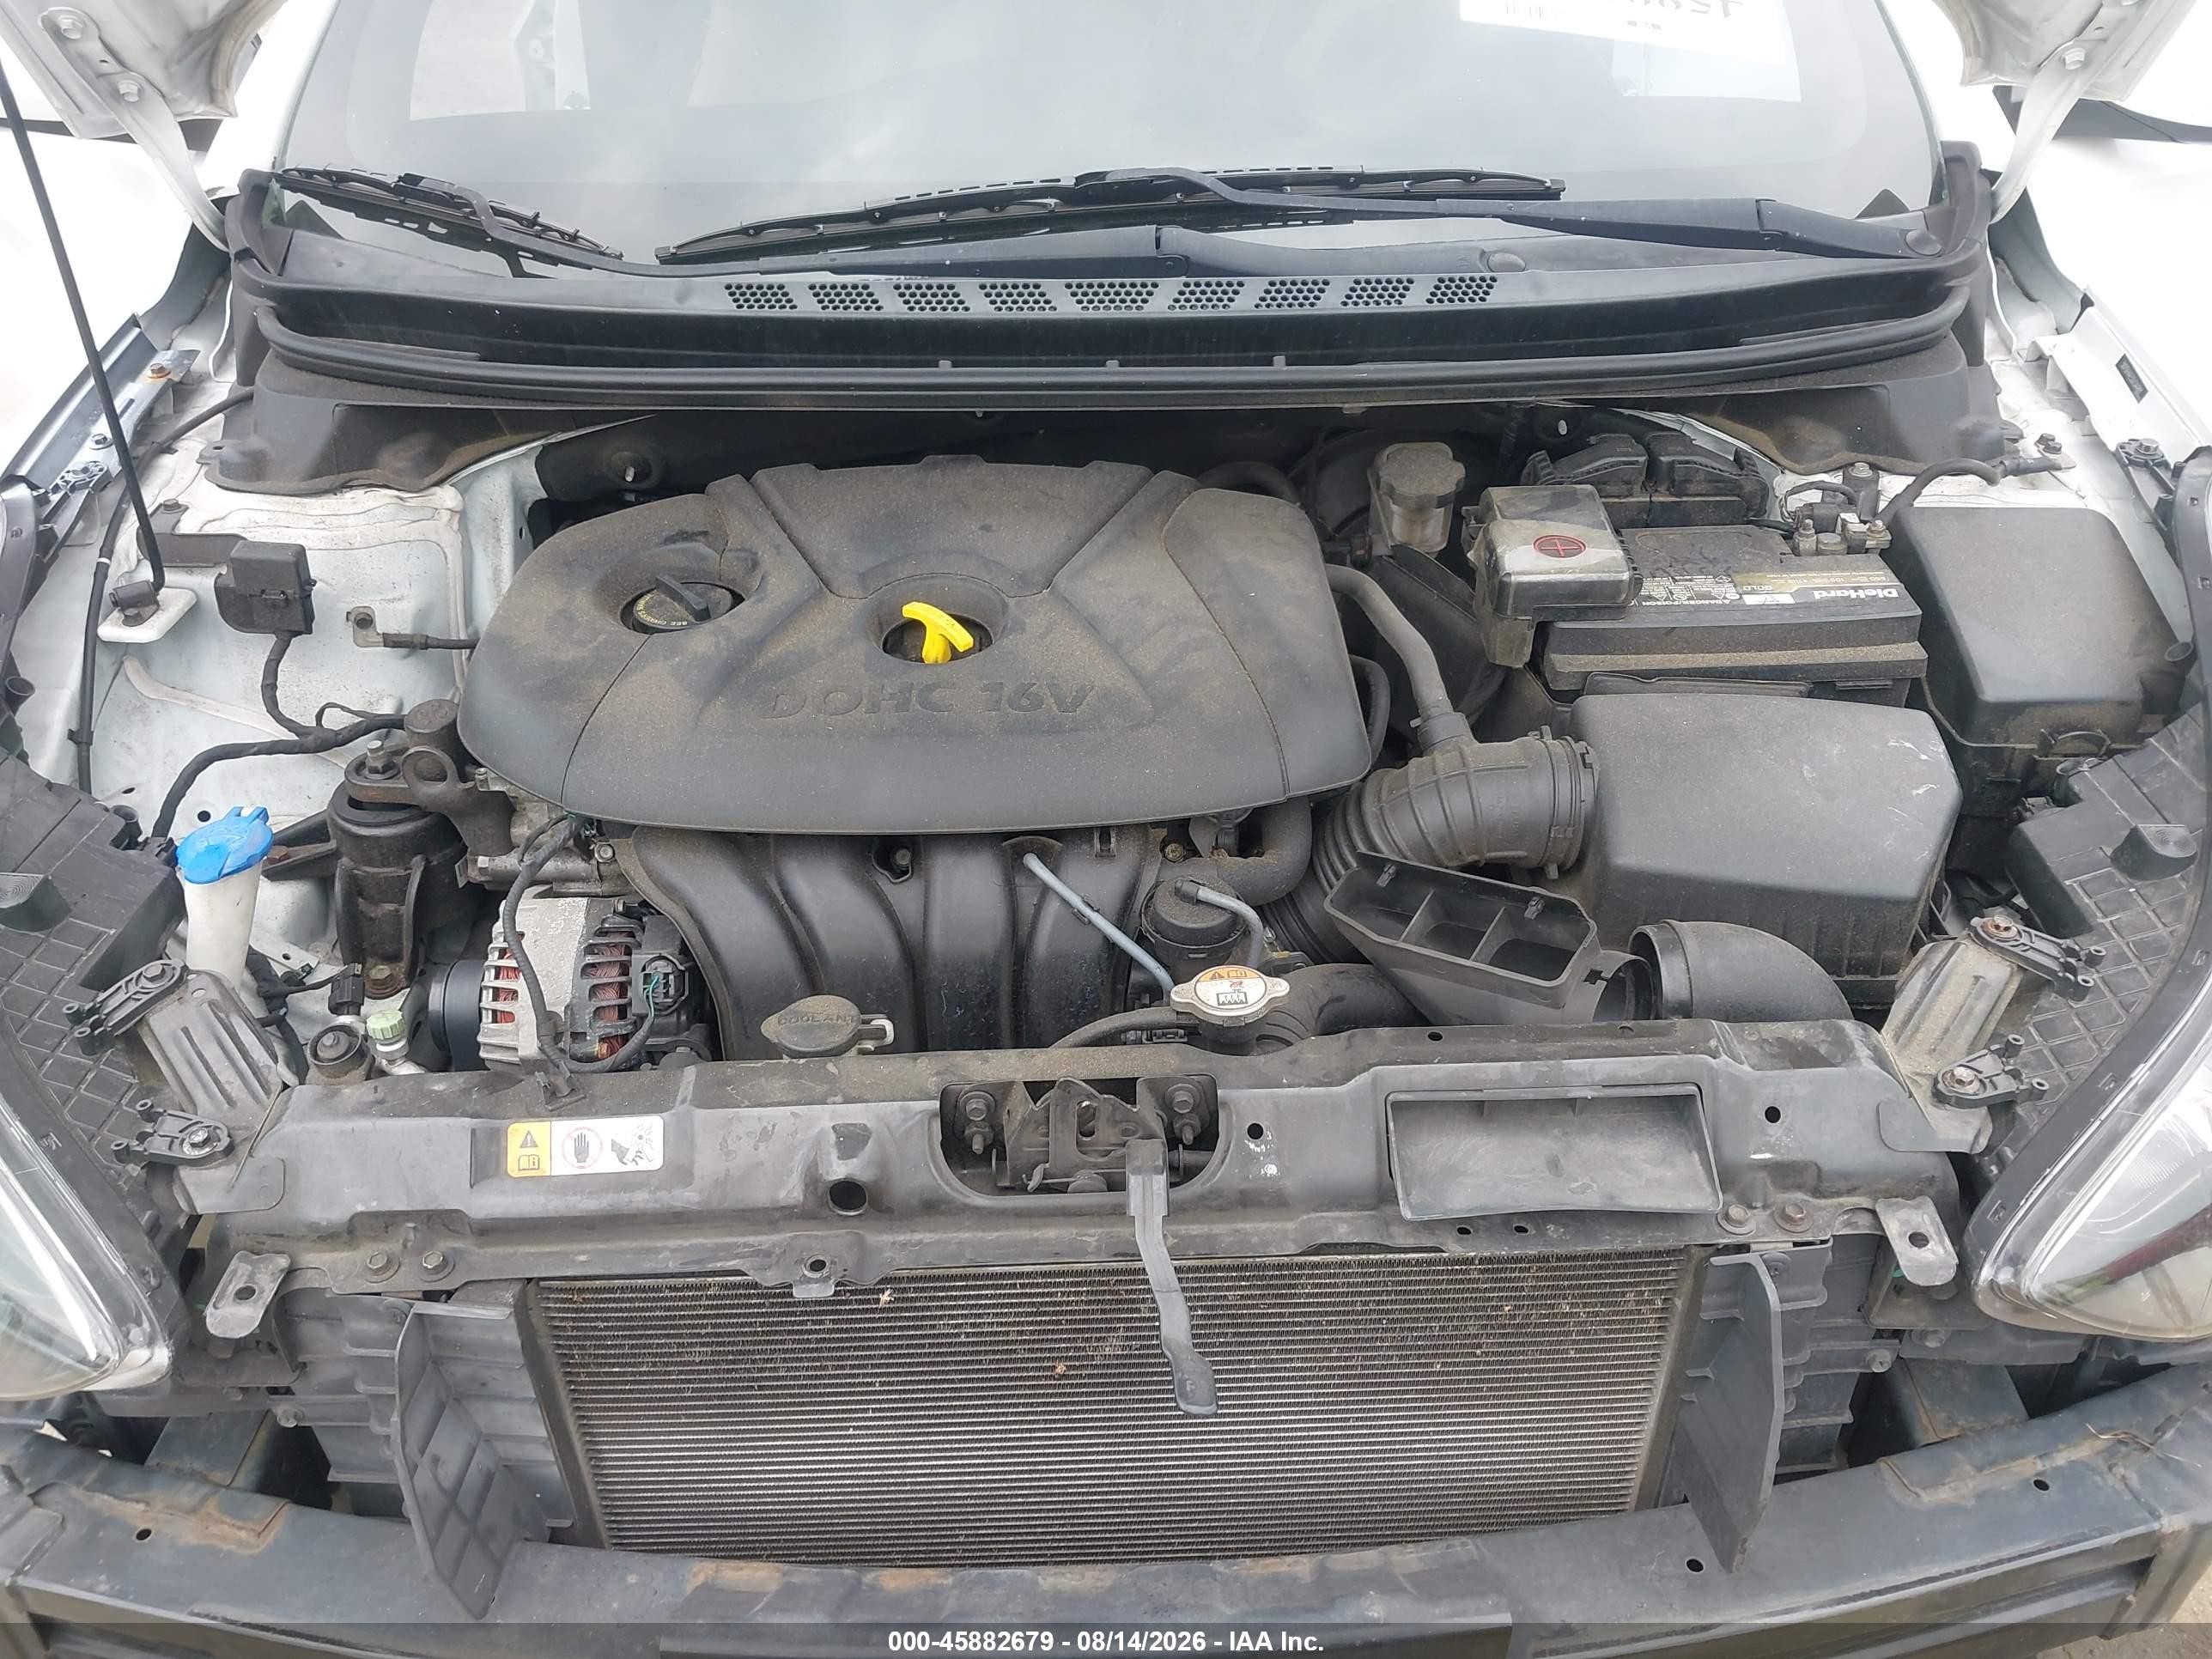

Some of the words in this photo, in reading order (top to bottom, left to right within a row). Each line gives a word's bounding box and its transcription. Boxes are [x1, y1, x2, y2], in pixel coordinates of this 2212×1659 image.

[1812, 587, 1899, 600] DieHard
[757, 681, 957, 719] DOHC
[979, 680, 1095, 714] 16V
[777, 1014, 854, 1025] COOLANT
